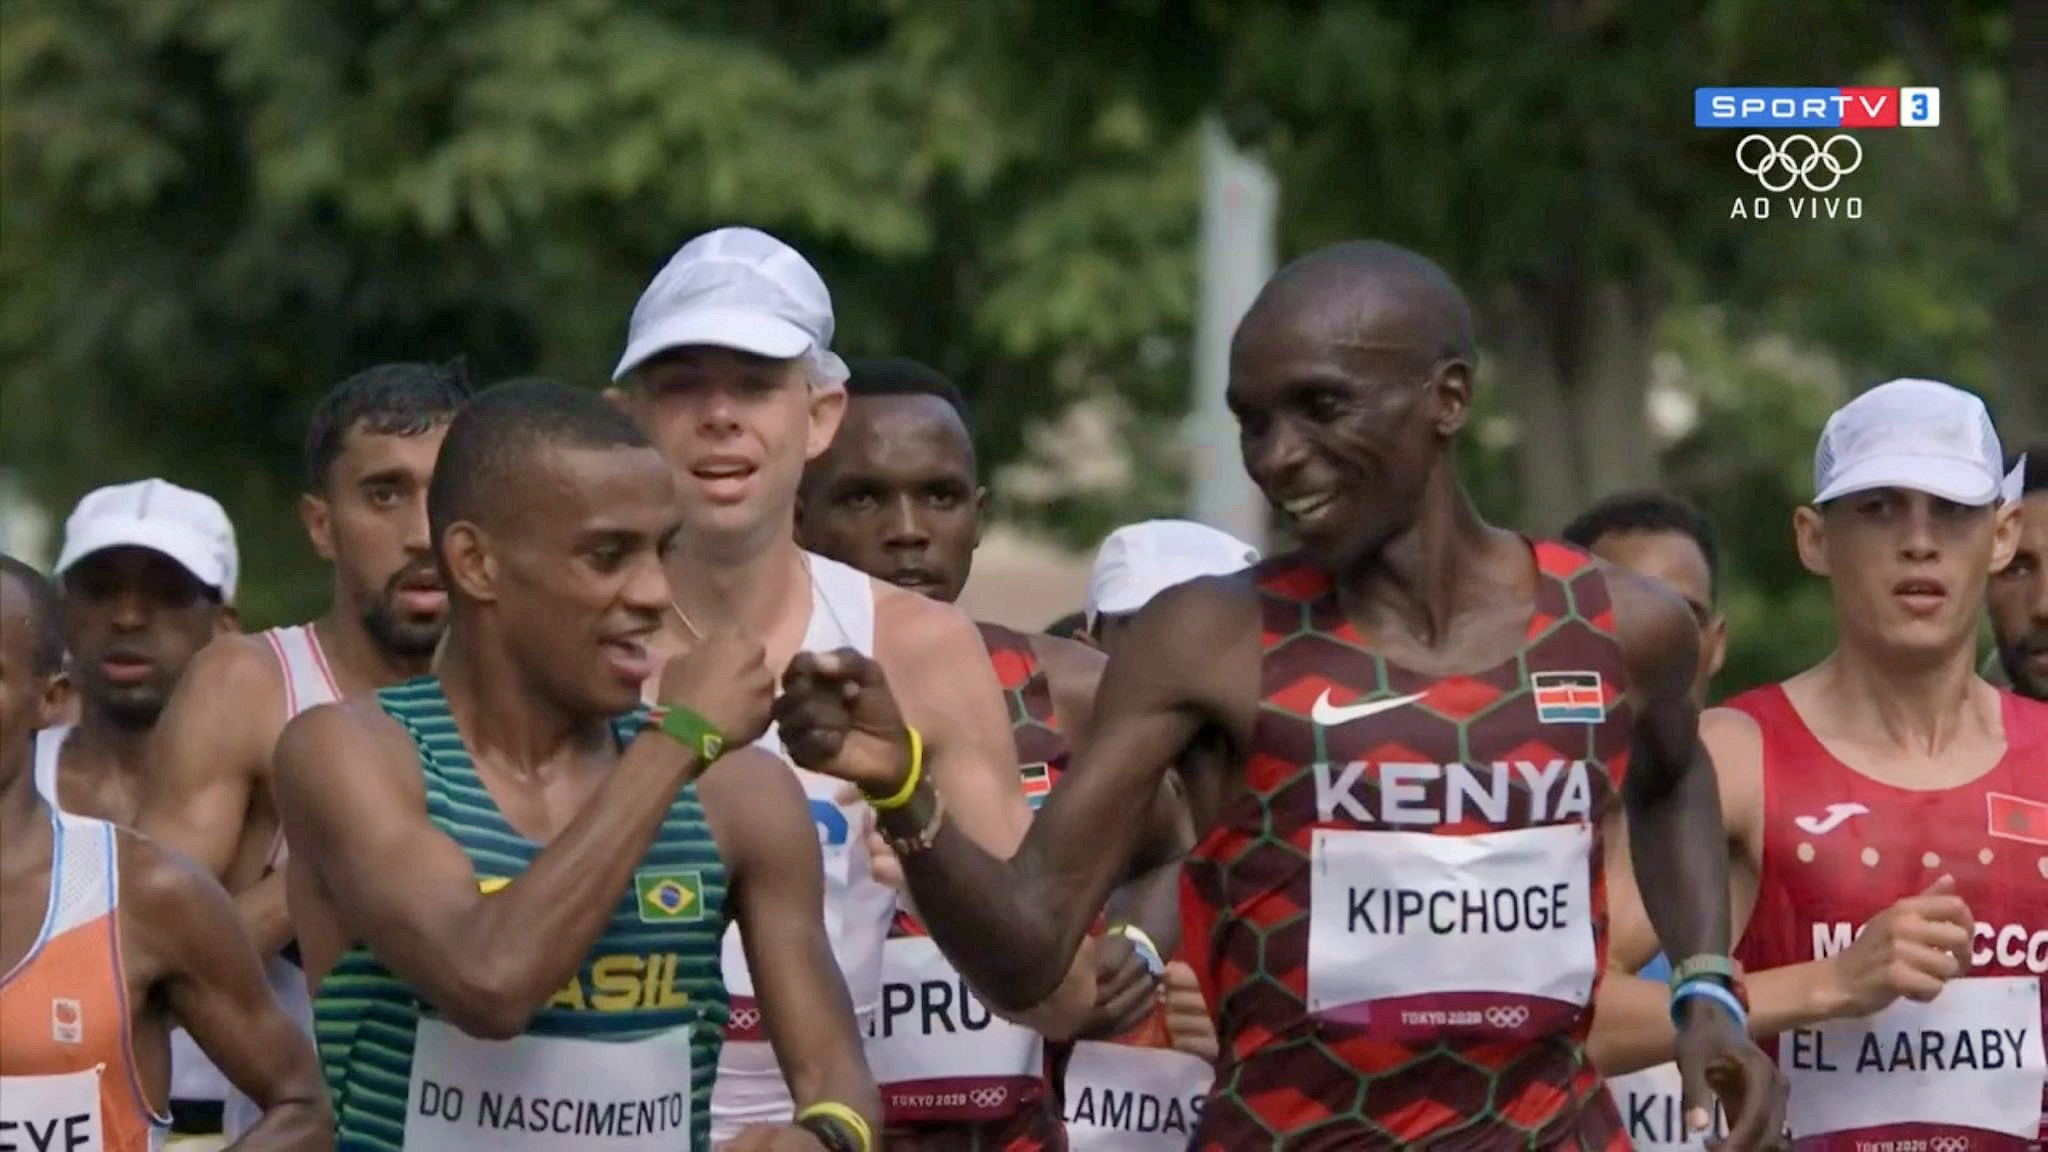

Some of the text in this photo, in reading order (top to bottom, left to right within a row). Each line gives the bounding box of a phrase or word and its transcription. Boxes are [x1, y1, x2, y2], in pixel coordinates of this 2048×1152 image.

[1313, 760, 1591, 824] KENYA
[1347, 883, 1570, 935] KIPCHOGE
[1401, 1011, 1482, 1025] TOKYO 2020
[1792, 1028, 2028, 1073] EL AARABY
[419, 1080, 684, 1137] DO NASCIMENTO
[892, 1093, 967, 1108] TOKYO 2020
